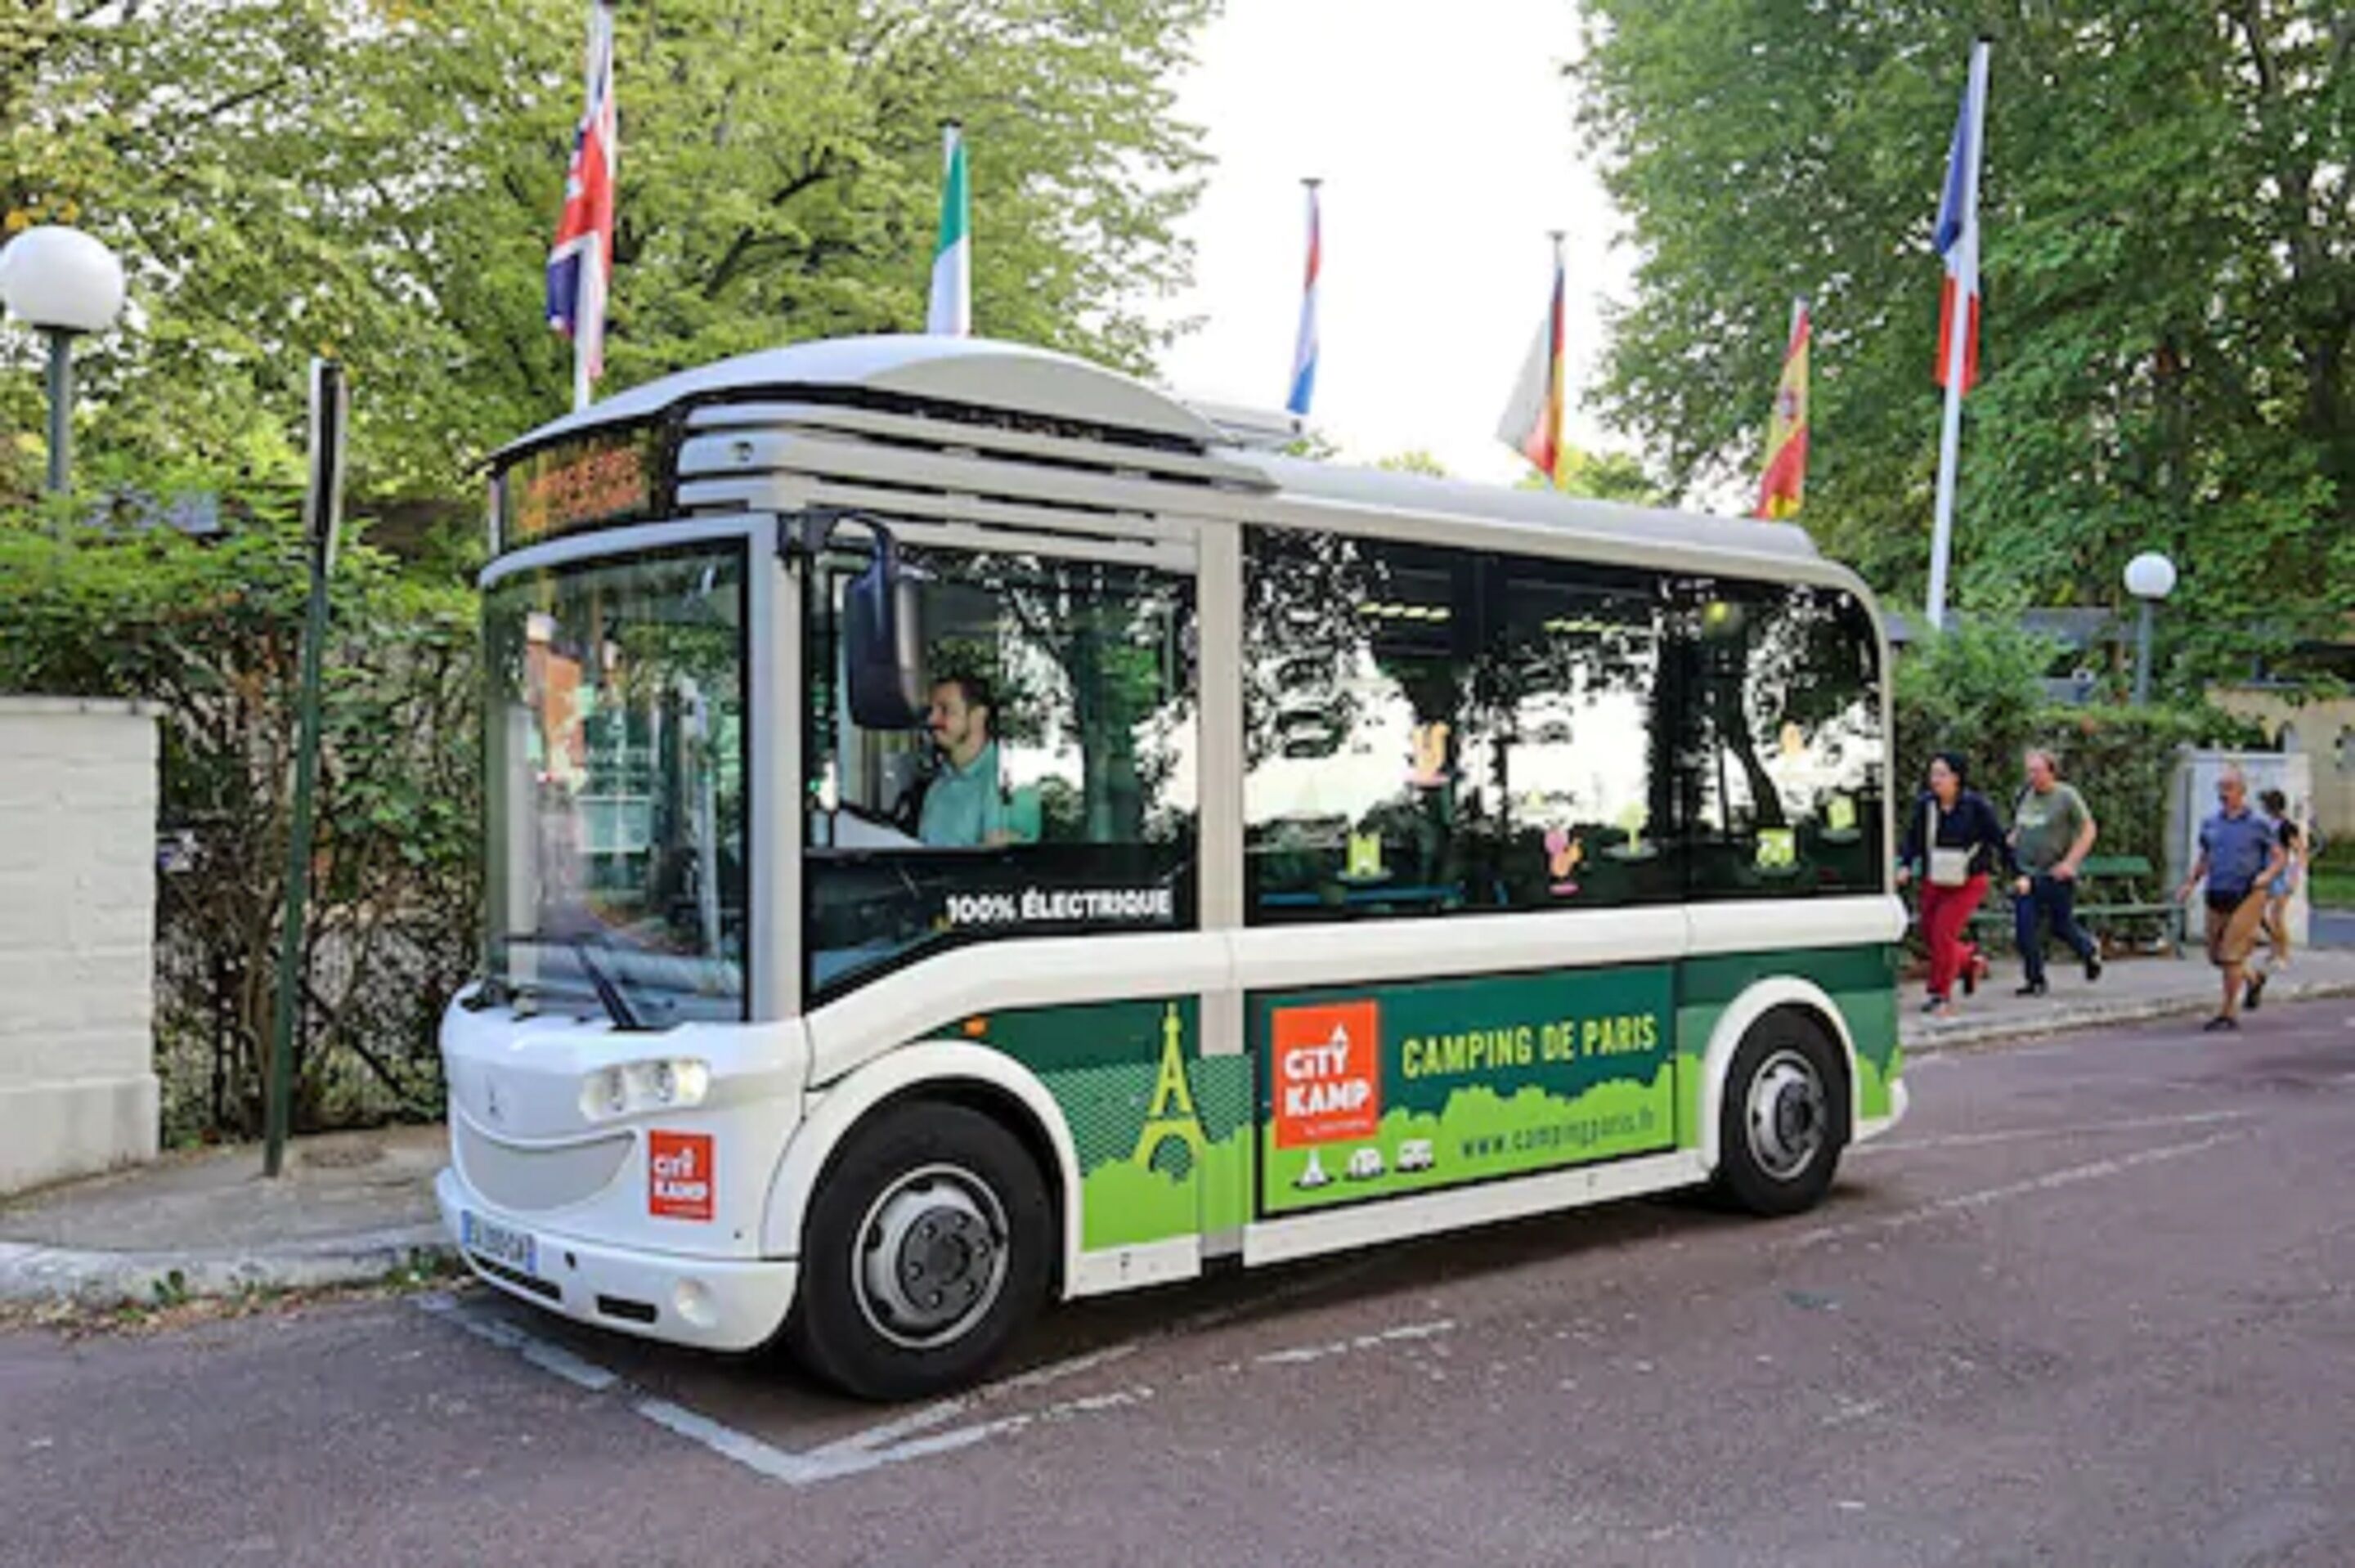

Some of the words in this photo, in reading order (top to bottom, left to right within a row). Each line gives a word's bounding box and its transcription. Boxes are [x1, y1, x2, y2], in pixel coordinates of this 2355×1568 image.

[946, 894, 1017, 922] 100%
[1022, 886, 1173, 919] ÉLECTRIQUE
[1402, 1028, 1532, 1078] CAMPING
[1541, 1024, 1573, 1060] DE
[1581, 1015, 1657, 1055] PARIS
[1285, 1077, 1371, 1118] KAMP
